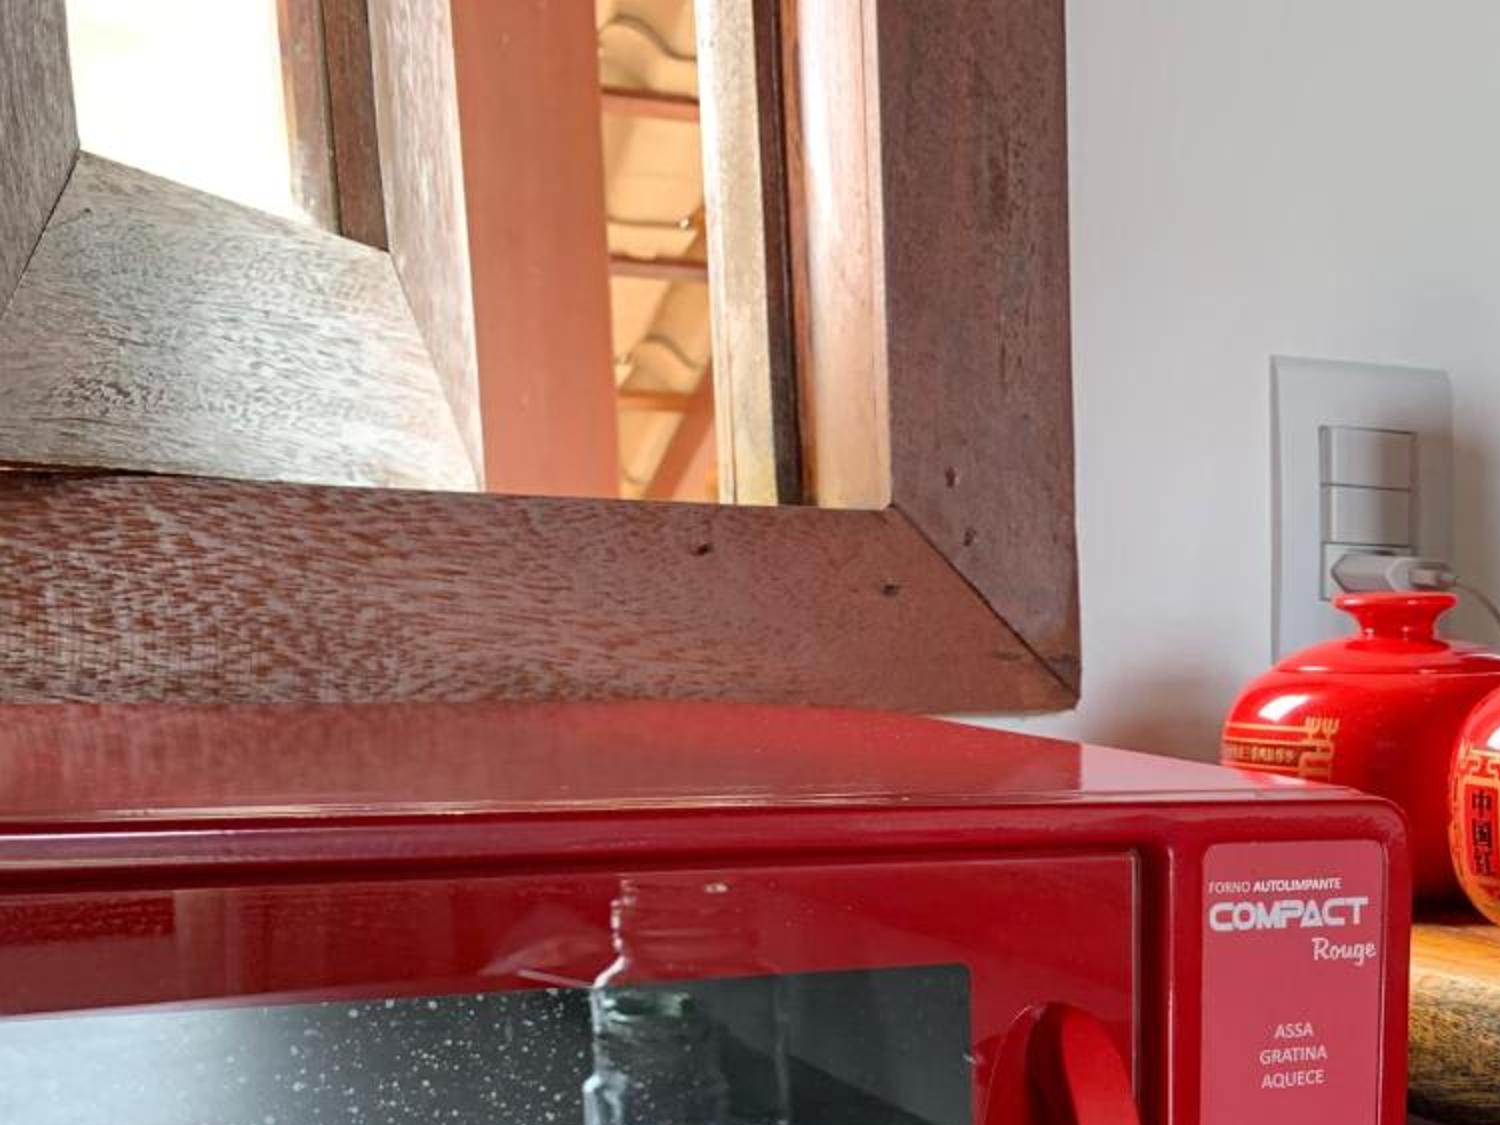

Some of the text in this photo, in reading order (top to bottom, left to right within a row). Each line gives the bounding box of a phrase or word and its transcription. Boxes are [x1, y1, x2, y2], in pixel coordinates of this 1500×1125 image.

[1208, 881, 1250, 893] FORNO
[1208, 896, 1369, 932] COMPACT
[1311, 937, 1376, 967] Rouge
[1274, 1022, 1313, 1039] ASSA
[1259, 1045, 1328, 1065] GRATINA
[1261, 1068, 1325, 1089] AQUECE
